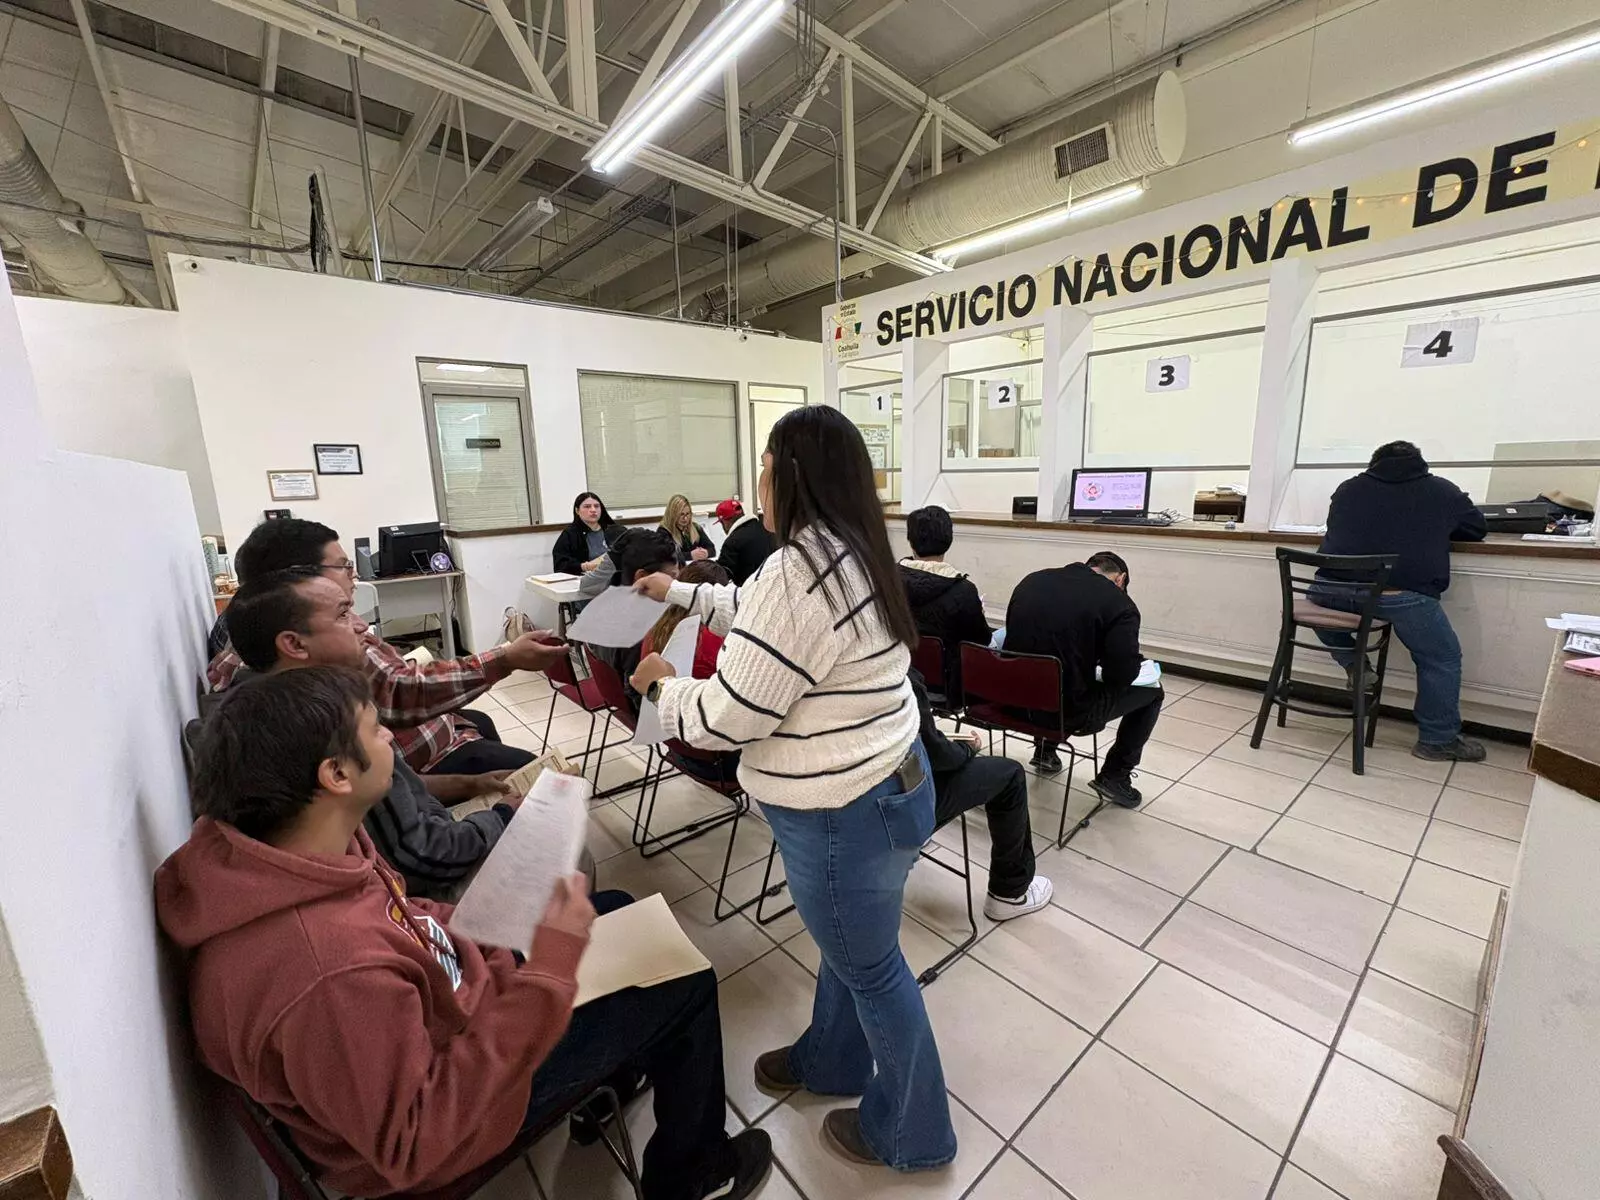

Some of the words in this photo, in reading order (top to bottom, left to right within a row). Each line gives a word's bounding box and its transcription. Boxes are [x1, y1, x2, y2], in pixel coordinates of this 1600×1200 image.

[876, 274, 1036, 346] SERVICIO
[1054, 187, 1371, 306] NACIONAL
[1412, 131, 1557, 228] DE
[1423, 330, 1453, 358] 4
[1159, 365, 1175, 387] 3
[876, 395, 883, 411] 1
[998, 386, 1011, 403] 2
